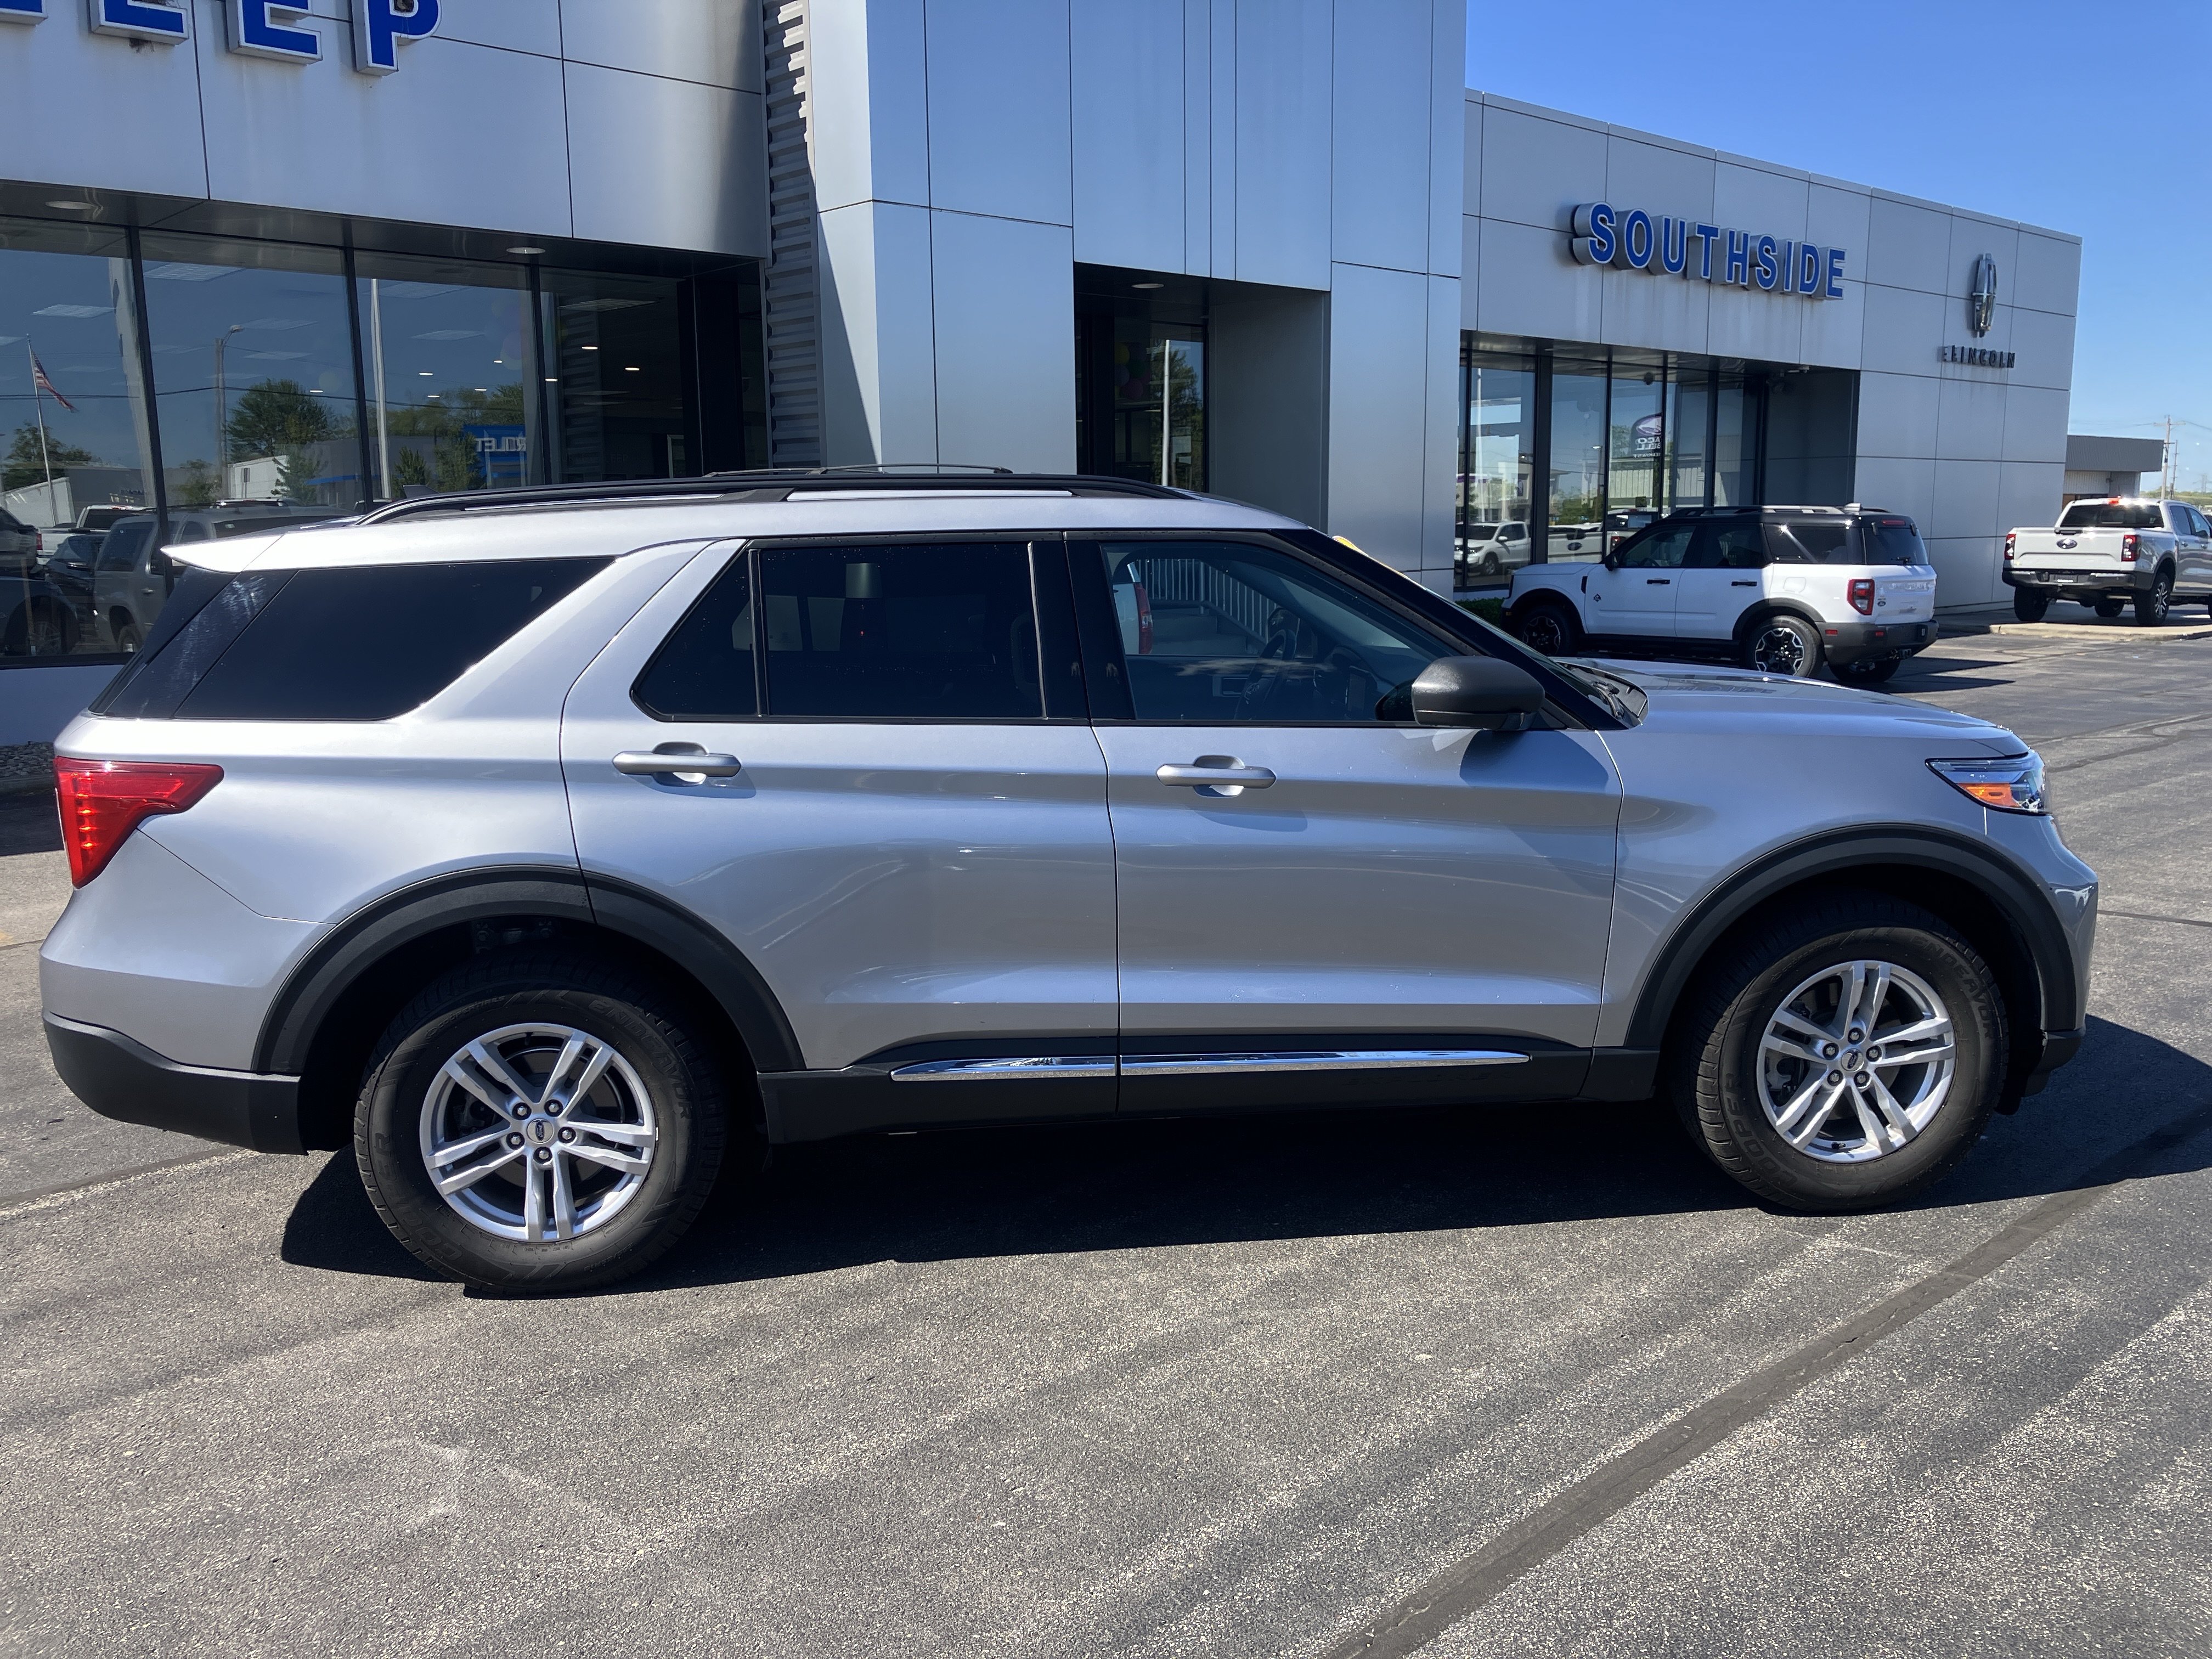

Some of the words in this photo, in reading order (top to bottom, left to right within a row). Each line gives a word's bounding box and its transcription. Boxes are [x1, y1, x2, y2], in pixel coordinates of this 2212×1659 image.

[1583, 201, 1847, 300] SOUTHSIDE
[1950, 344, 2016, 368] LINCOLN
[589, 1000, 691, 1119] ENDEAVOR
[1726, 1073, 1798, 1186] COOPER
[374, 1132, 462, 1261] COOPER
